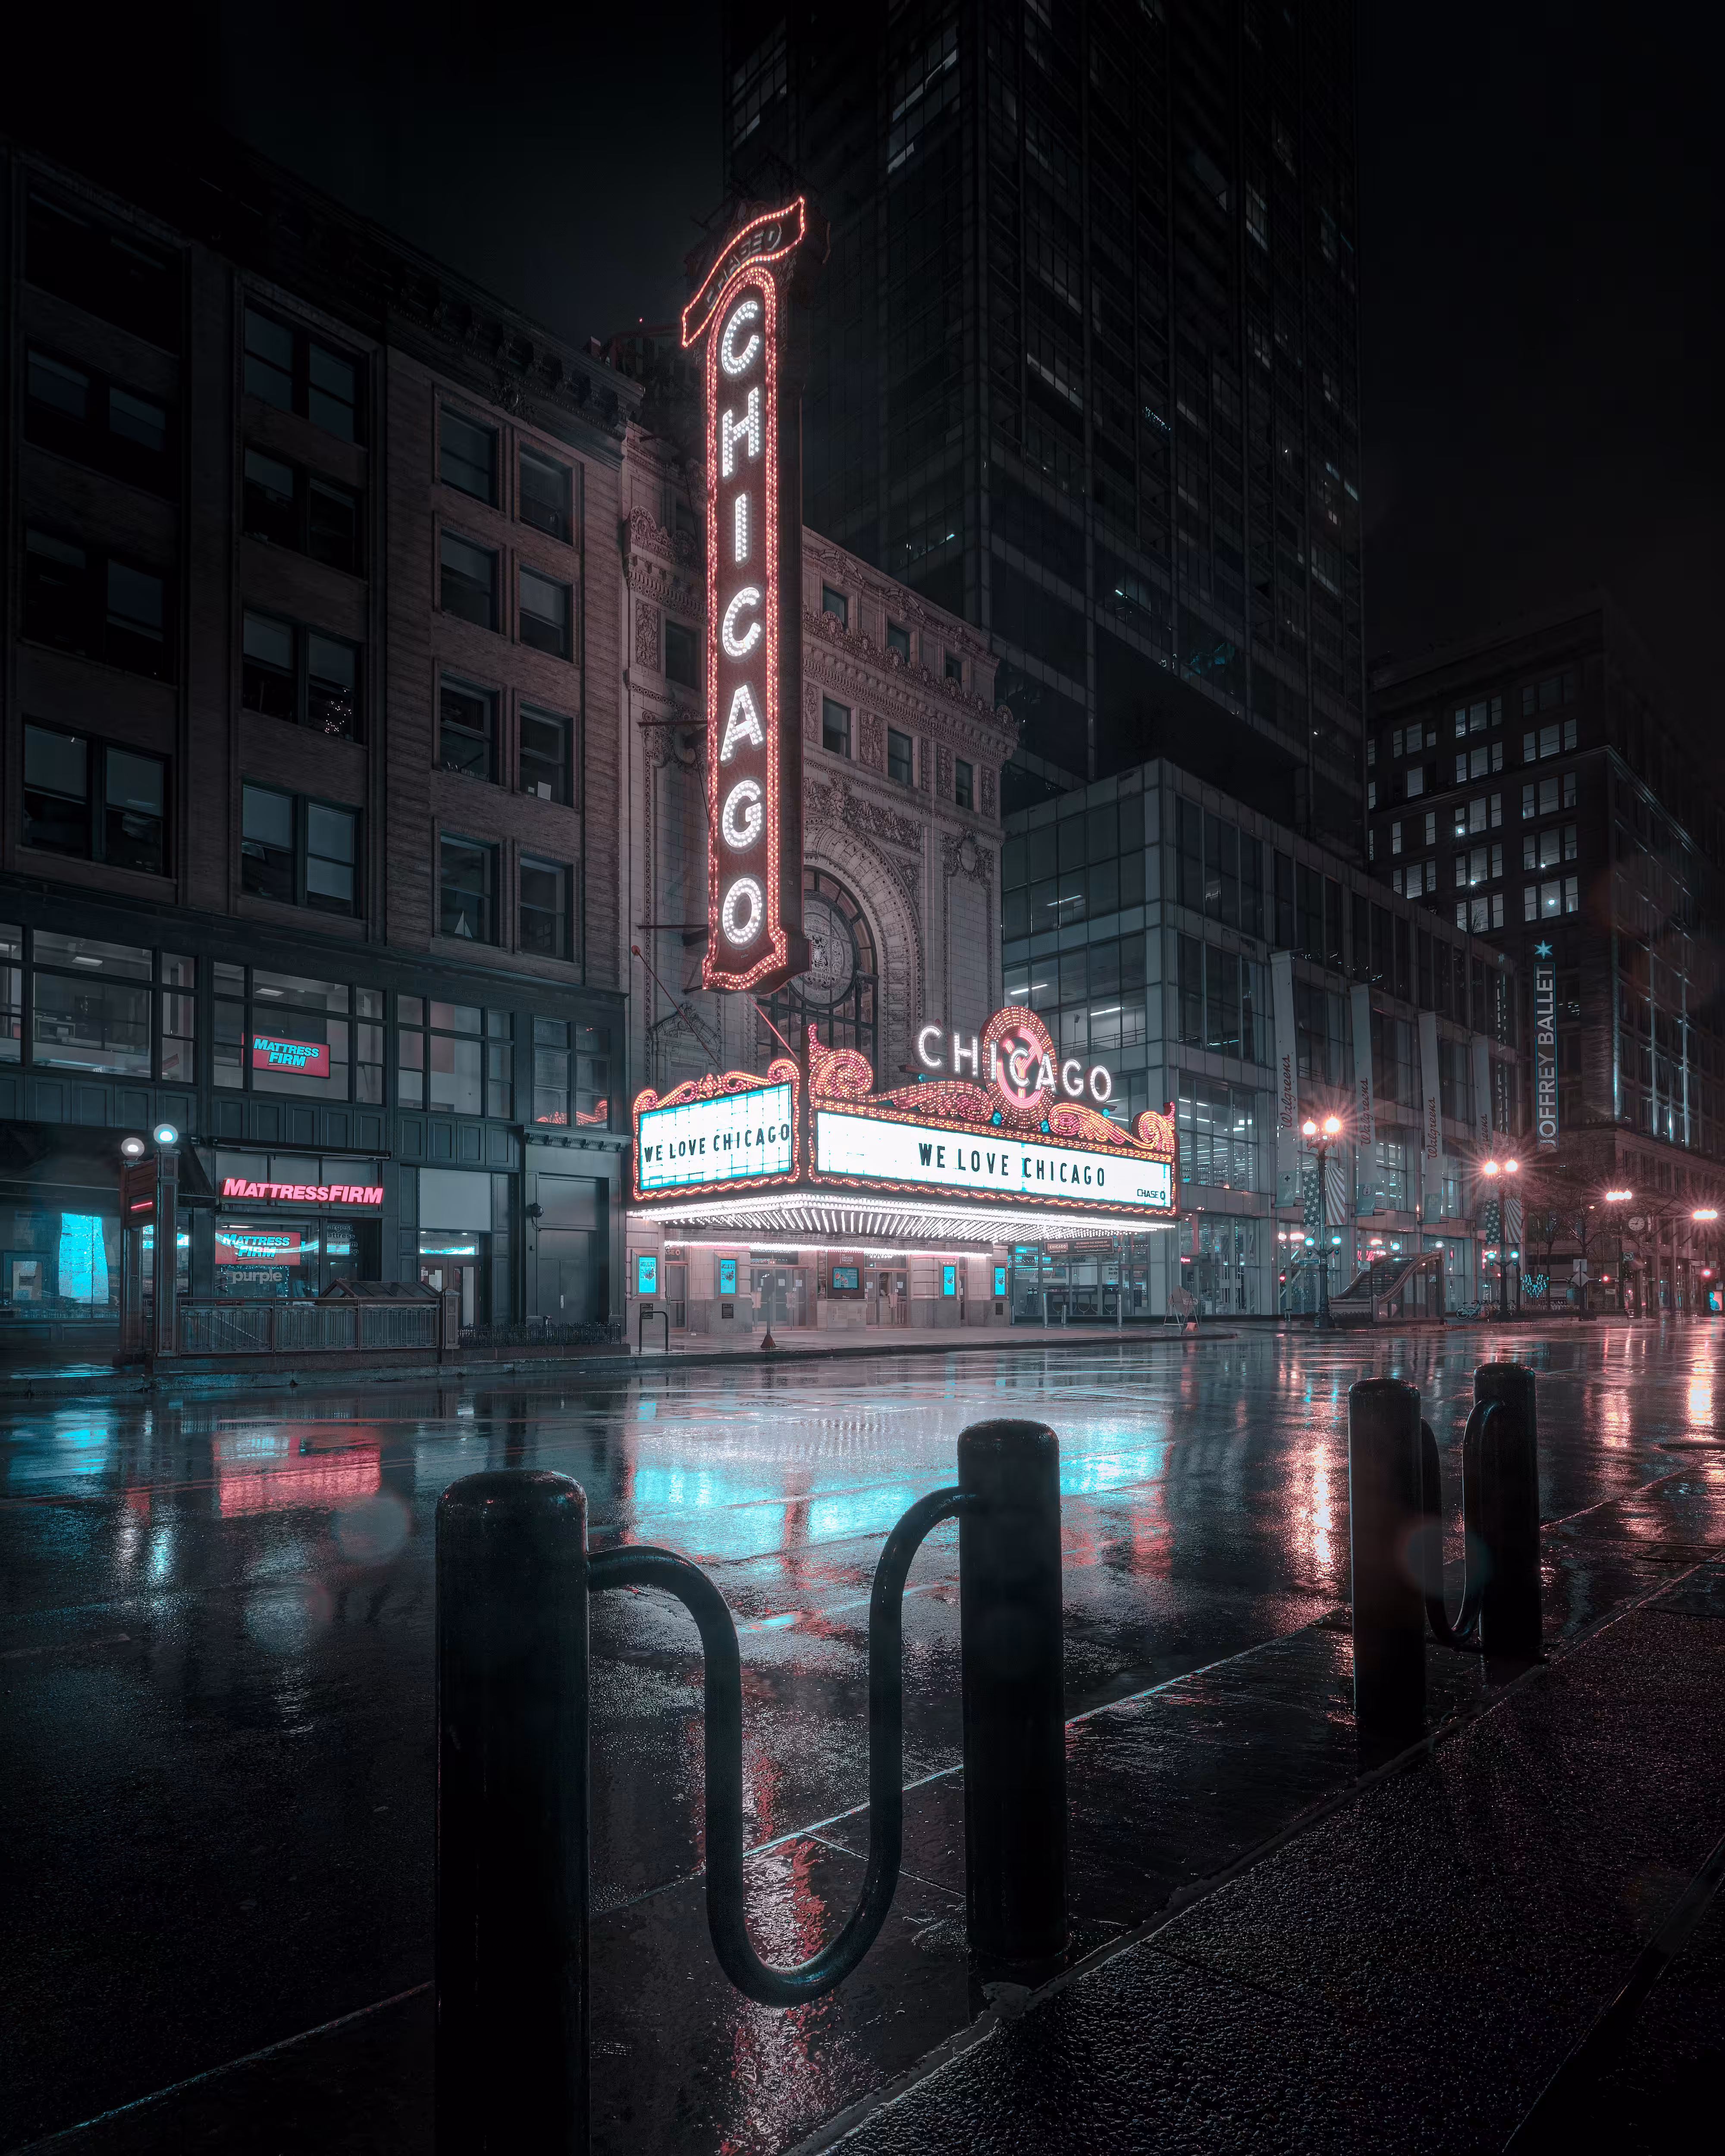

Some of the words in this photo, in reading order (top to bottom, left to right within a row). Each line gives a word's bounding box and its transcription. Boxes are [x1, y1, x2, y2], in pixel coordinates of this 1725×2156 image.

[721, 301, 764, 944] CHICAGO
[1536, 966, 1554, 1045] BALLET
[254, 1038, 319, 1057] MATTRESS
[269, 1051, 306, 1067] FIRM
[919, 1025, 1112, 1102] CHICAGO
[1280, 1054, 1296, 1129] Walgreens
[1359, 1078, 1374, 1147] Walgreens
[1538, 1052, 1556, 1145] JOFFREY
[644, 1145, 662, 1162] WE
[670, 1138, 706, 1159] LOVE
[713, 1124, 789, 1151] CHICAGO
[1427, 1097, 1440, 1159] Walgreens
[919, 1143, 945, 1168] WE
[958, 1149, 1009, 1176] LOVE
[1023, 1158, 1104, 1186] CHICAGO
[1137, 1189, 1159, 1198] CHASE
[222, 1234, 291, 1246] MATTRESS
[238, 1246, 276, 1257] FIRM
[232, 1269, 283, 1285] purple
